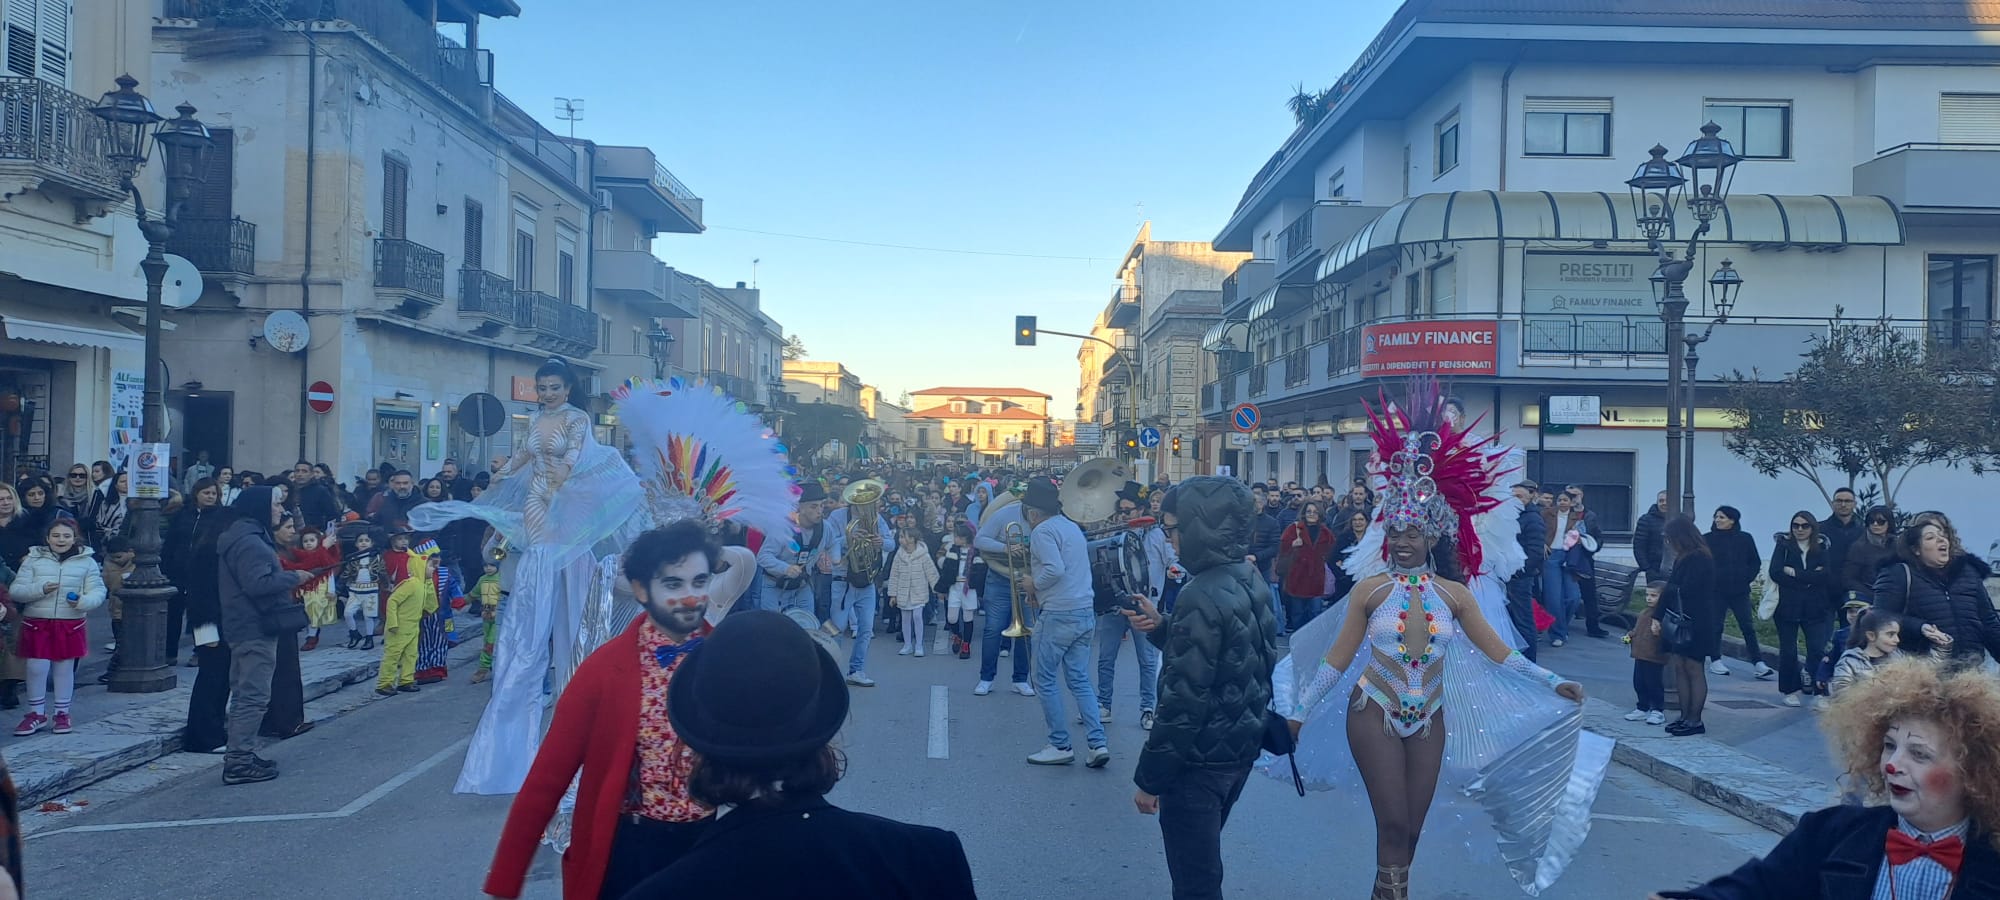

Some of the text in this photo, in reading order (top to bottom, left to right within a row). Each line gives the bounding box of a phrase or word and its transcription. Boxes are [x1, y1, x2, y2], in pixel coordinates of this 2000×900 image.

[1560, 263, 1634, 277] PRESTITI
[1569, 298, 1643, 307] FAMILY FINANCE
[1379, 331, 1493, 347] FAMILY FINANCE
[1381, 363, 1386, 371] A
[1387, 361, 1429, 370] DIPENDENTI
[1431, 361, 1436, 369] E
[1439, 361, 1492, 369] PENSIONATI
[1600, 410, 1625, 422] NL
[380, 417, 416, 431] OVERKIDS
